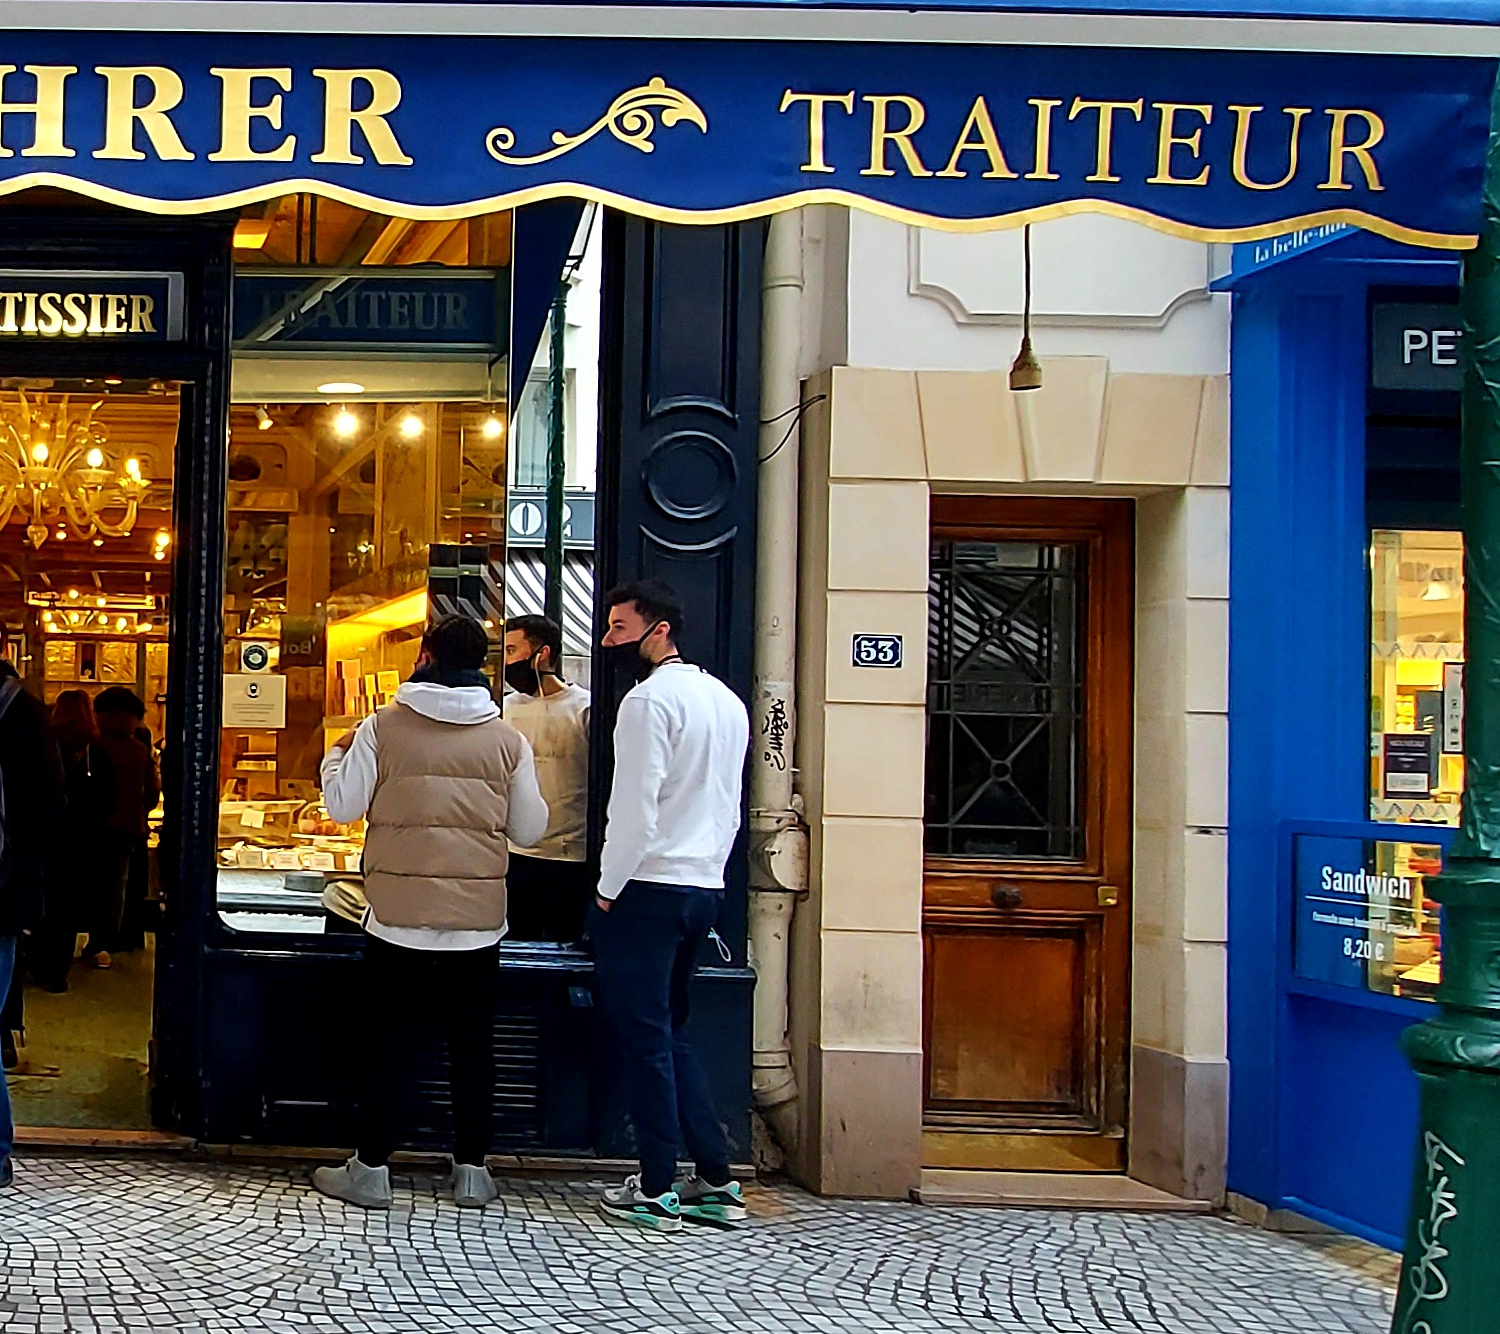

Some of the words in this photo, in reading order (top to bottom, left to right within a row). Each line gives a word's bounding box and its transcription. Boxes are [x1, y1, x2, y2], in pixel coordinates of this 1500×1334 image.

[778, 89, 1387, 192] TRAITEUR
[1254, 245, 1269, 264] la
[1403, 329, 1463, 365] PE
[860, 640, 895, 662] 53
[1321, 865, 1412, 901] Sandwich
[1343, 937, 1372, 960] 8,20
[1375, 942, 1386, 961] €
